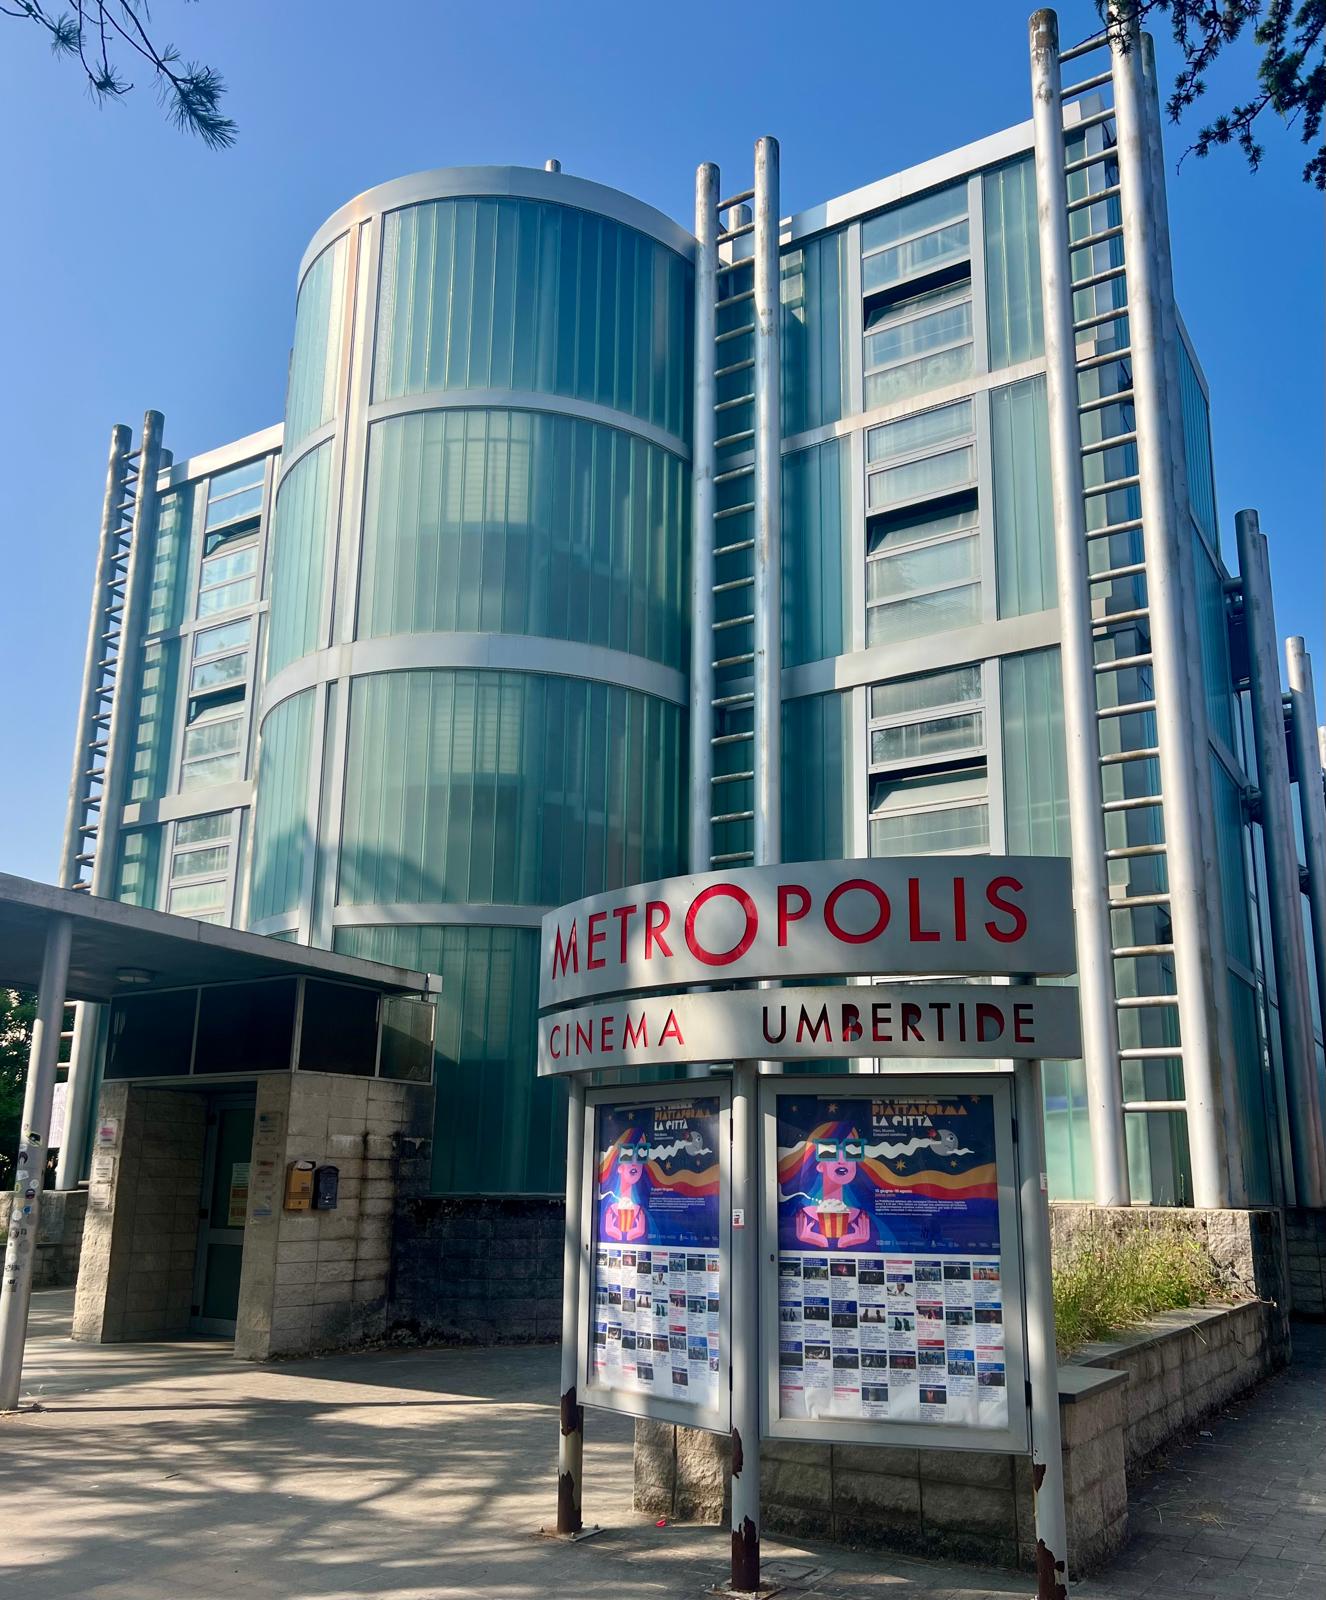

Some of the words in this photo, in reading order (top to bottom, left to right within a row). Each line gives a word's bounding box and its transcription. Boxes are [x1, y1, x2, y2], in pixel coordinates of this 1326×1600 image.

[552, 876, 1027, 980] METROPOLIS
[550, 1008, 685, 1059] CINEMA
[762, 1003, 1035, 1044] UMBERTIDE
[872, 1104, 967, 1115] PIATTAFORMA
[654, 1121, 664, 1130] LA
[873, 1116, 889, 1126] LA
[892, 1115, 933, 1126] CITTÀ
